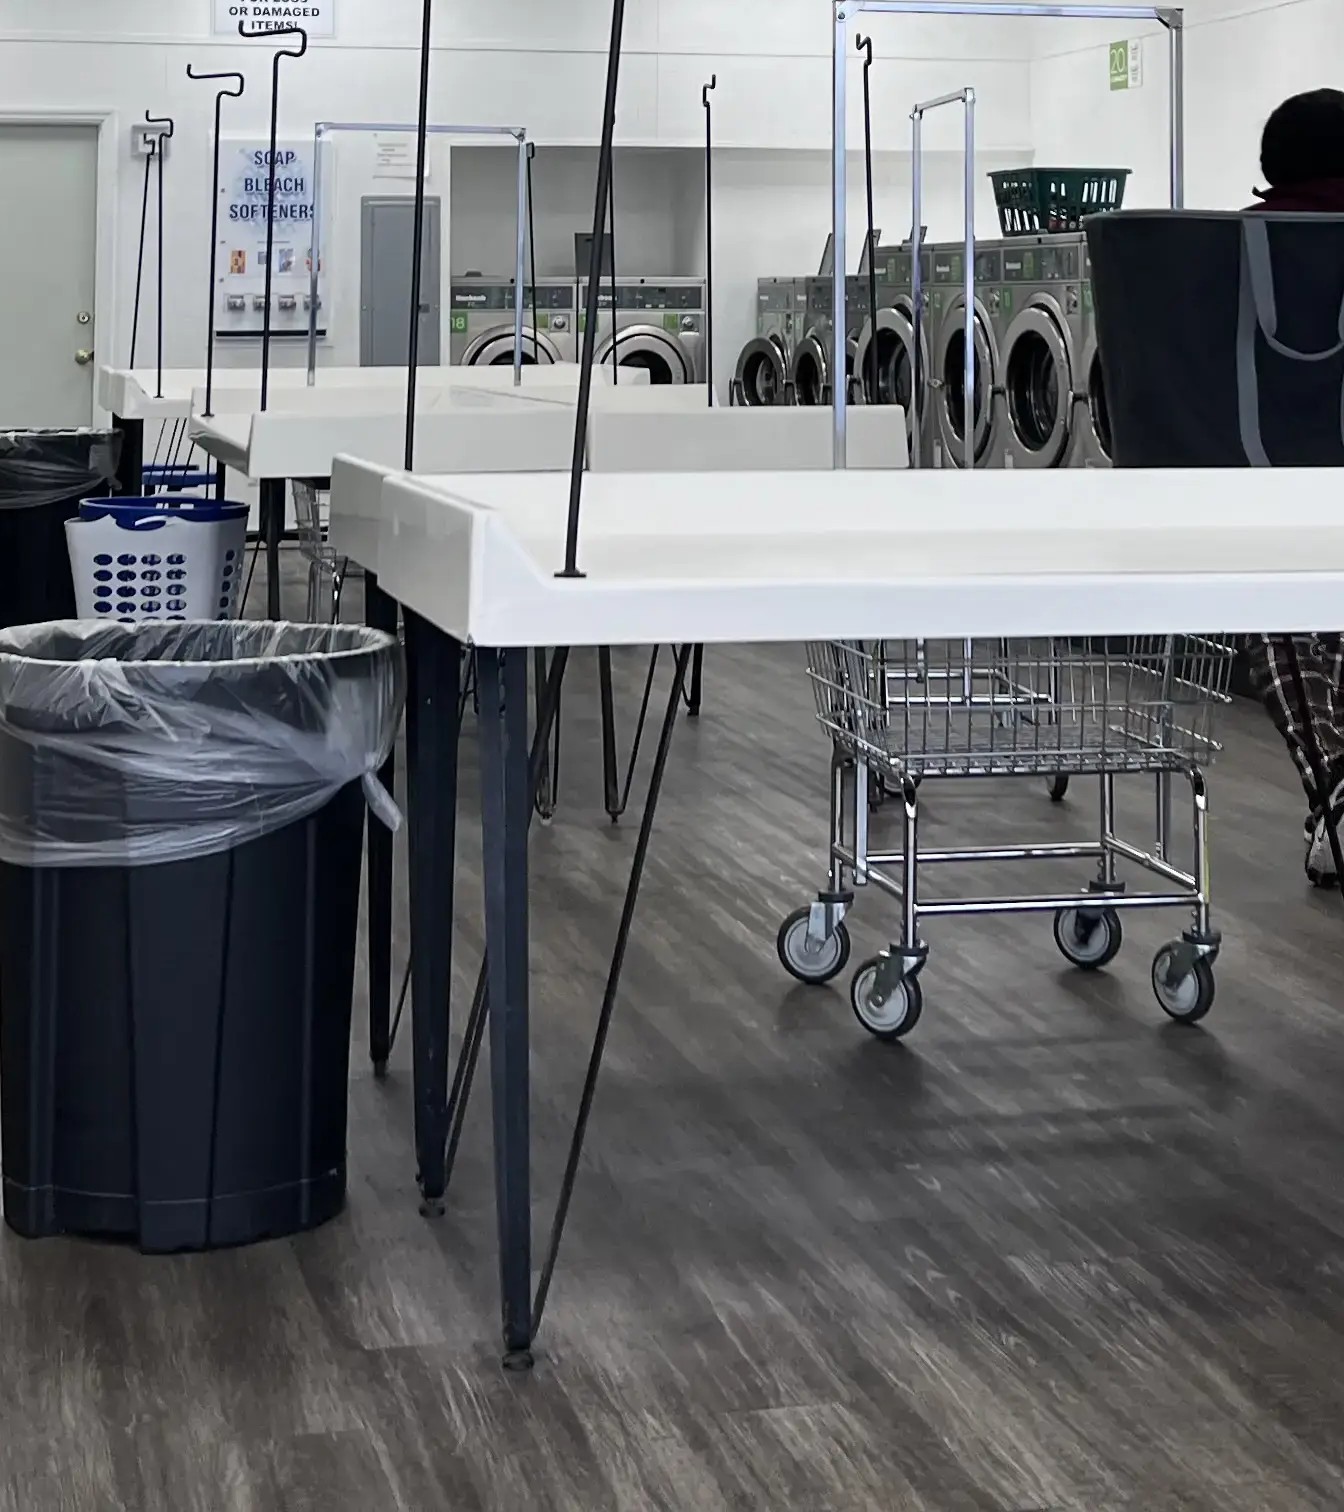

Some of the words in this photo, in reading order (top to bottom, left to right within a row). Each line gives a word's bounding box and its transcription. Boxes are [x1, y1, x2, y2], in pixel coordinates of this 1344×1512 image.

[229, 6, 248, 16] OR
[253, 7, 320, 17] DAMAGED
[251, 20, 299, 31] ITEMS!
[244, 177, 305, 192] BLEACH
